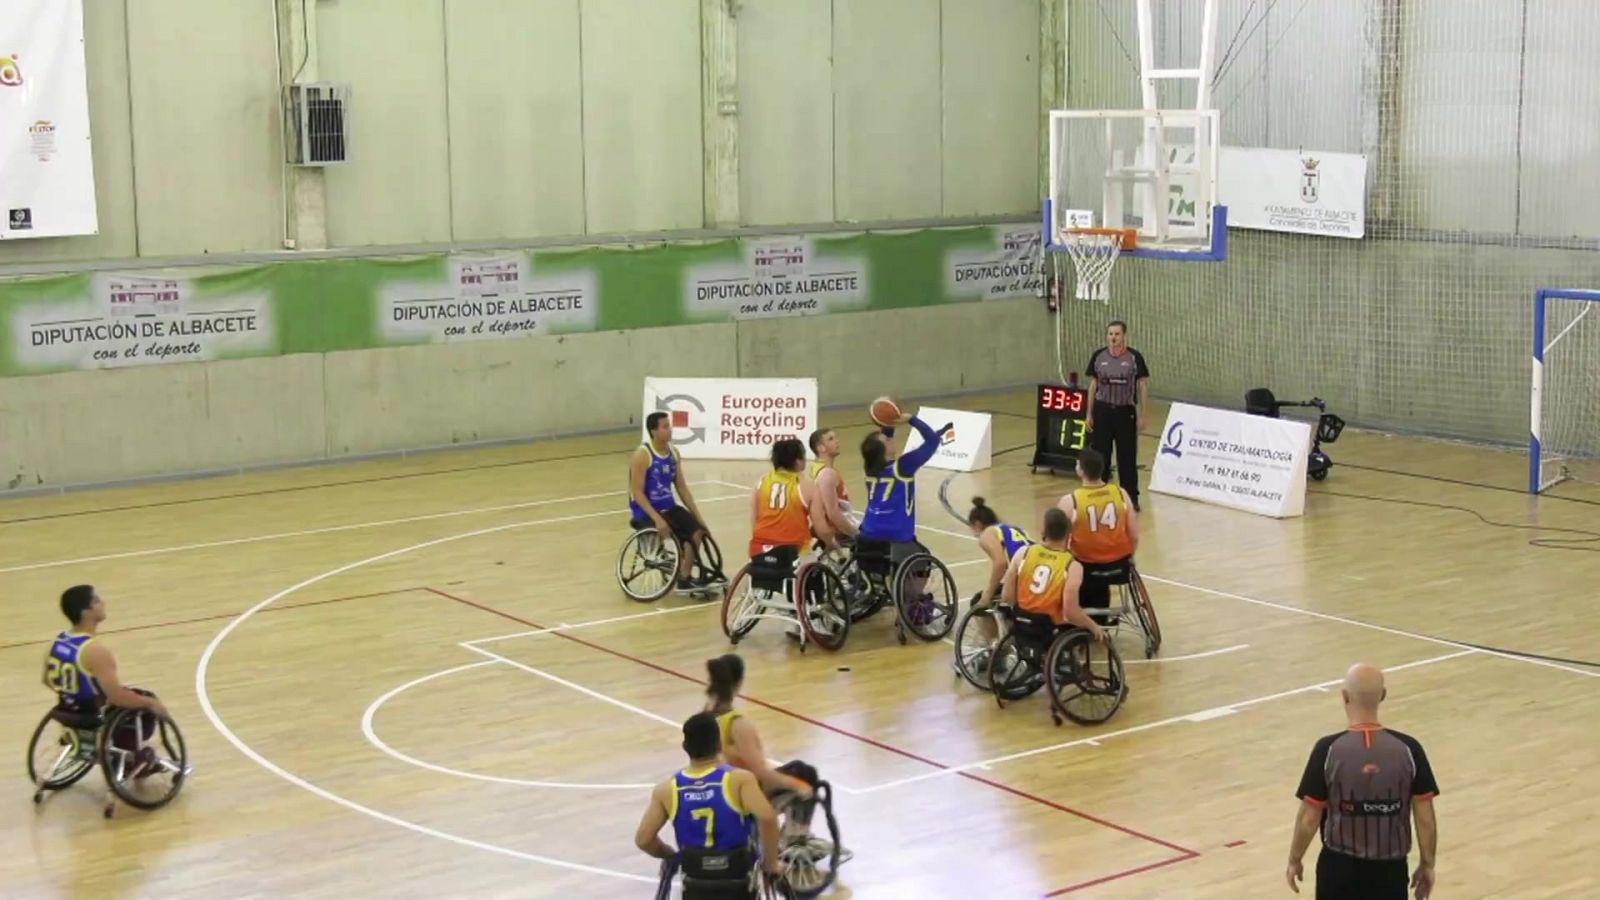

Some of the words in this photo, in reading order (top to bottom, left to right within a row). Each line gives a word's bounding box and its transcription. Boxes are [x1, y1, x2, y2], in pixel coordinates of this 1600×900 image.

[955, 263, 1019, 282] DIPUTACIÓN
[697, 278, 773, 301] DIPUTACIÓN
[775, 281, 792, 296] DE
[795, 277, 858, 294] ALBACETE
[393, 301, 482, 321] DIPUTACIÓN
[487, 300, 505, 316] DE
[509, 296, 583, 313] ALBACETE
[740, 303, 758, 314] con
[763, 300, 774, 312] el
[777, 298, 818, 313] deporte
[32, 320, 137, 346] DIPUTACIÓN
[142, 322, 164, 338] DE
[169, 315, 257, 336] ALBACETE
[444, 324, 466, 336] con
[471, 321, 484, 334] el
[488, 318, 537, 334] deporte
[93, 349, 117, 360] con
[124, 344, 138, 357] el
[144, 341, 201, 357] deporte
[722, 395, 806, 412] European
[721, 413, 806, 430] Recycling
[1060, 419, 1086, 450] 13
[769, 482, 787, 509] 11
[865, 477, 896, 503] 77
[1087, 502, 1117, 532] 14
[1029, 564, 1051, 595] 9
[691, 807, 714, 848] 7
